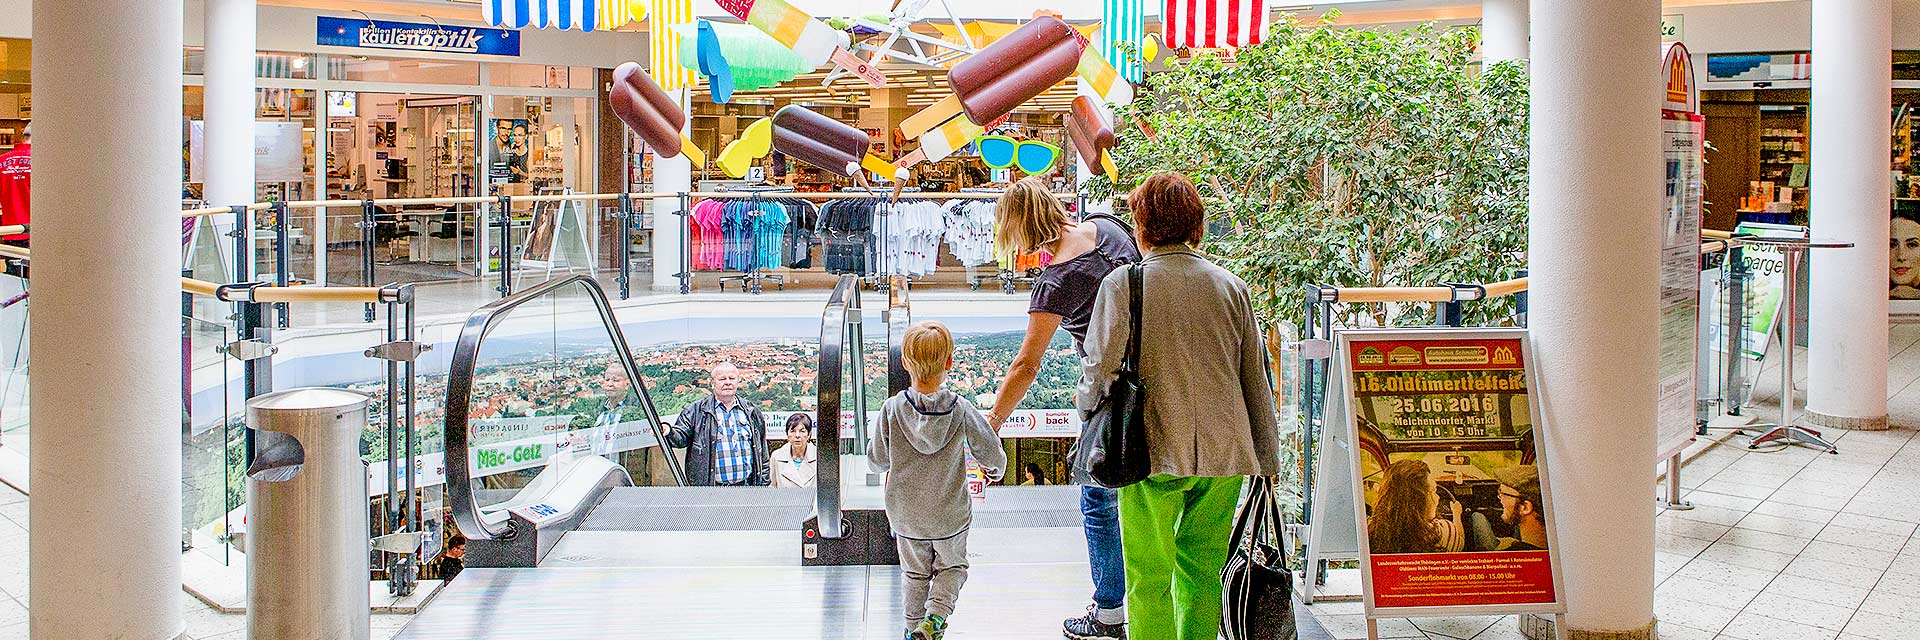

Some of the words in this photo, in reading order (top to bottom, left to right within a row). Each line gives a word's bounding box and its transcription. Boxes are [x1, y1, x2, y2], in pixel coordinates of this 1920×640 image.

[397, 28, 452, 36] Kontaktlinen
[360, 27, 483, 52] kaulenoptik
[754, 168, 761, 178] 2
[1001, 170, 1005, 180] 1
[1743, 256, 1784, 276] parge
[1393, 397, 1494, 413] 25.06.2016
[1394, 416, 1464, 426] Melchendorfer
[1466, 416, 1495, 425] Markt
[1406, 428, 1424, 437] von
[1429, 427, 1441, 436] 10
[1453, 427, 1464, 436] 15
[1468, 427, 1484, 436] Uhr
[477, 444, 542, 469] Mäc-Geiz
